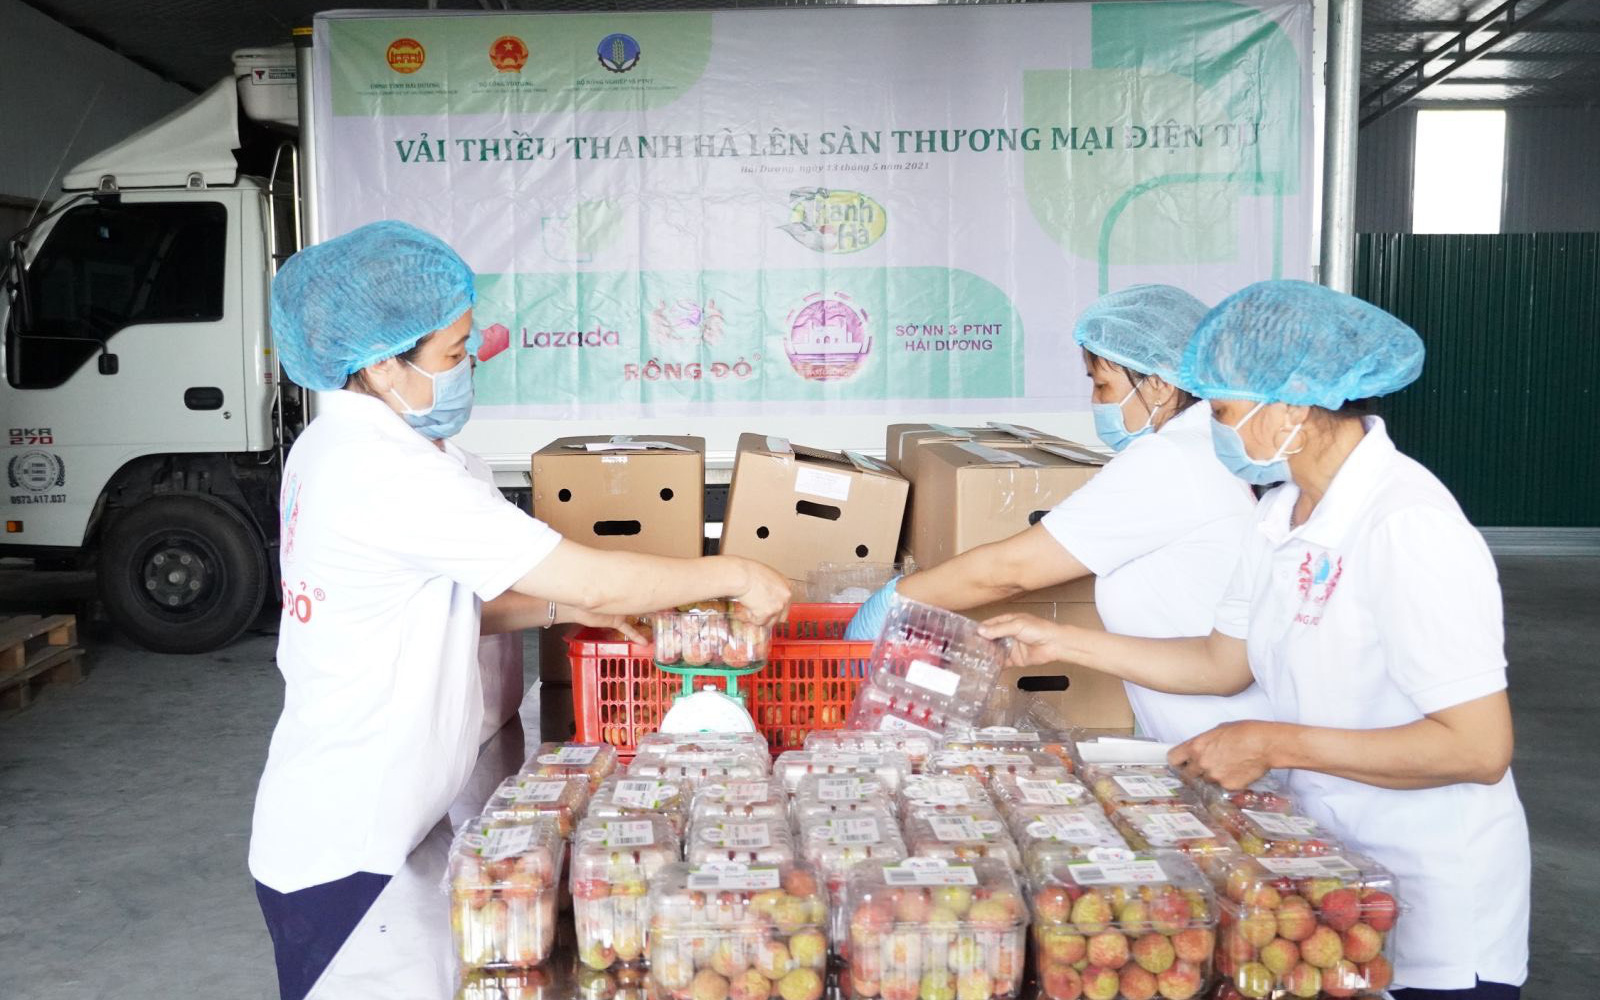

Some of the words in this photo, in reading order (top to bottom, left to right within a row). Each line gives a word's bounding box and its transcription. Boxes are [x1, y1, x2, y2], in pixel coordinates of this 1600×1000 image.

[394, 133, 446, 163] VẢI
[455, 130, 556, 161] THIỀU
[566, 134, 684, 160] THANH
[693, 127, 740, 158] HÀ
[749, 126, 809, 156] LÊN
[818, 124, 882, 155] SÀN
[891, 127, 1041, 154] THƯƠNG
[1051, 125, 1115, 156] MẠI
[1124, 118, 1205, 154] ĐIỆN
[871, 162, 879, 171] 5
[904, 161, 929, 171] 2021
[895, 323, 920, 337] SỞ
[922, 324, 944, 337] NN
[963, 324, 1003, 337] PTNT
[522, 327, 620, 349] Lazada
[905, 338, 931, 352] HẢI
[935, 338, 993, 351] DƯƠNG
[10, 437, 53, 445] 270
